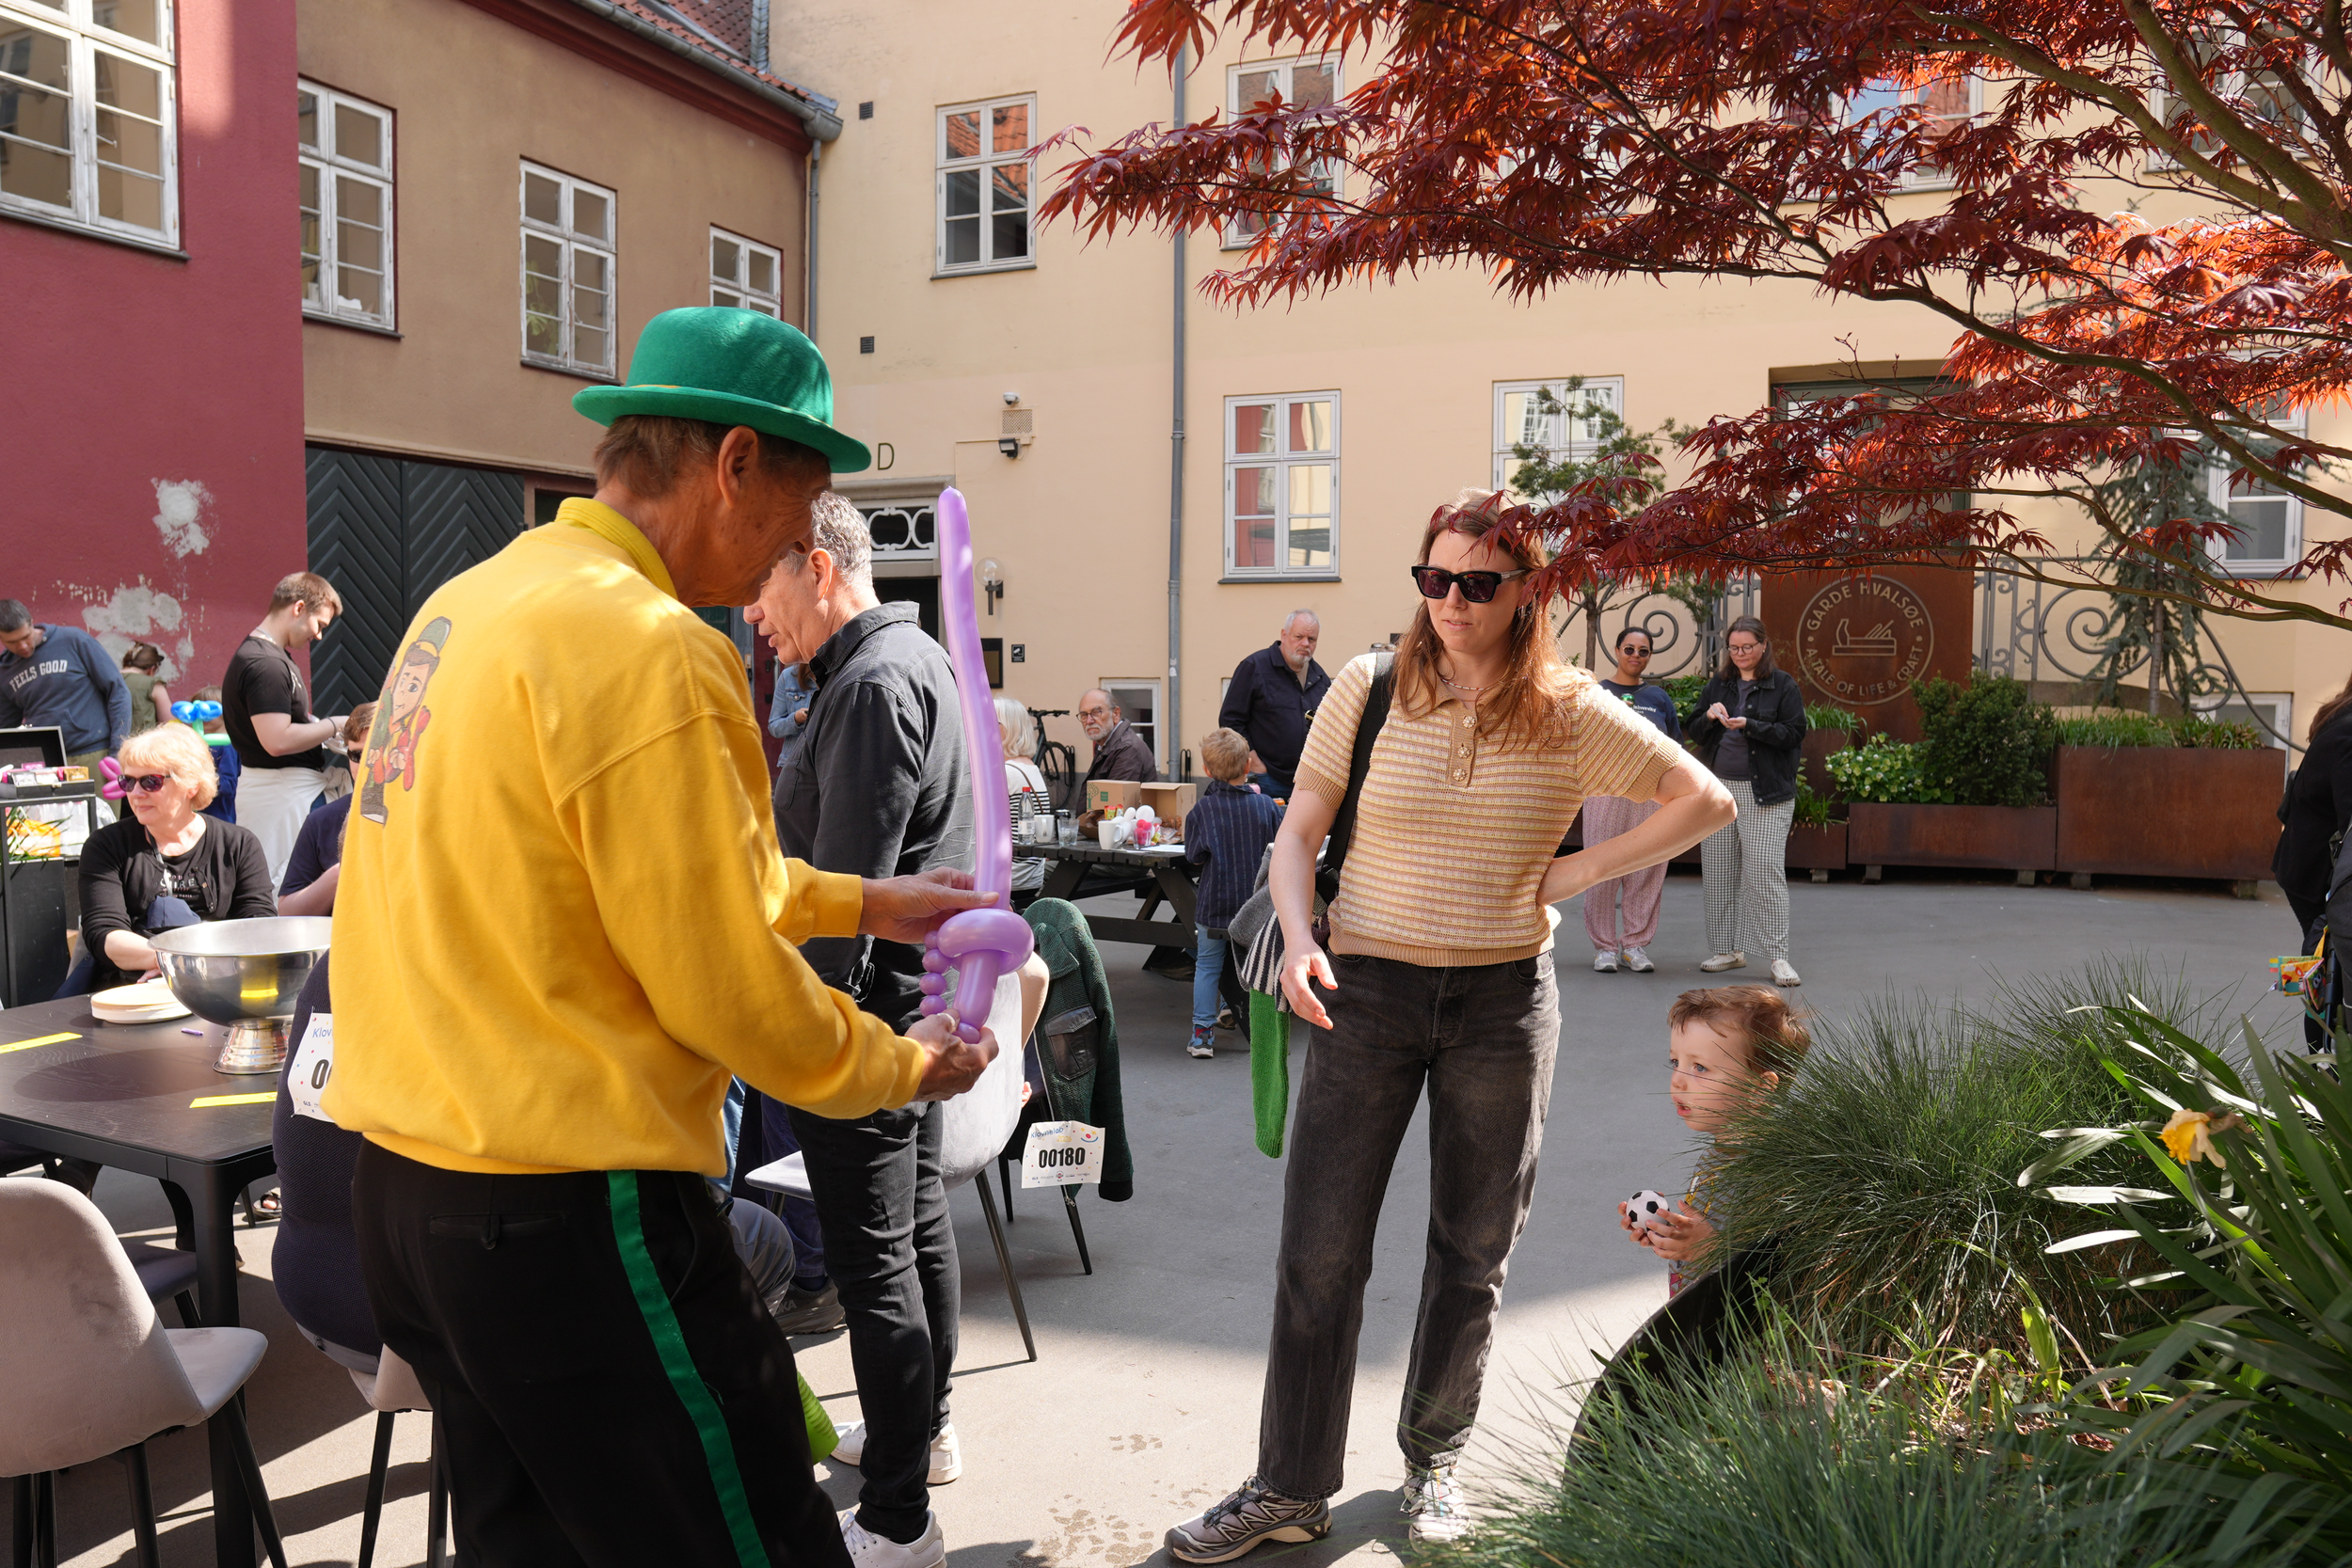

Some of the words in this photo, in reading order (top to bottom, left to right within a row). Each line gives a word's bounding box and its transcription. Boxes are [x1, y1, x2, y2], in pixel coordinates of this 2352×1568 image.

[1806, 585, 1851, 630] GARDE
[1860, 582, 1924, 628] HVALSØE
[8, 666, 38, 692] FEELS
[39, 659, 68, 676] GOOD
[1806, 648, 1818, 657] A
[1812, 658, 1836, 685] TALE
[1836, 680, 1855, 694] OF
[1859, 682, 1885, 696] LIFE
[1887, 679, 1898, 690] &
[1897, 645, 1923, 681] CRAFT
[1039, 1148, 1086, 1168] 00180
